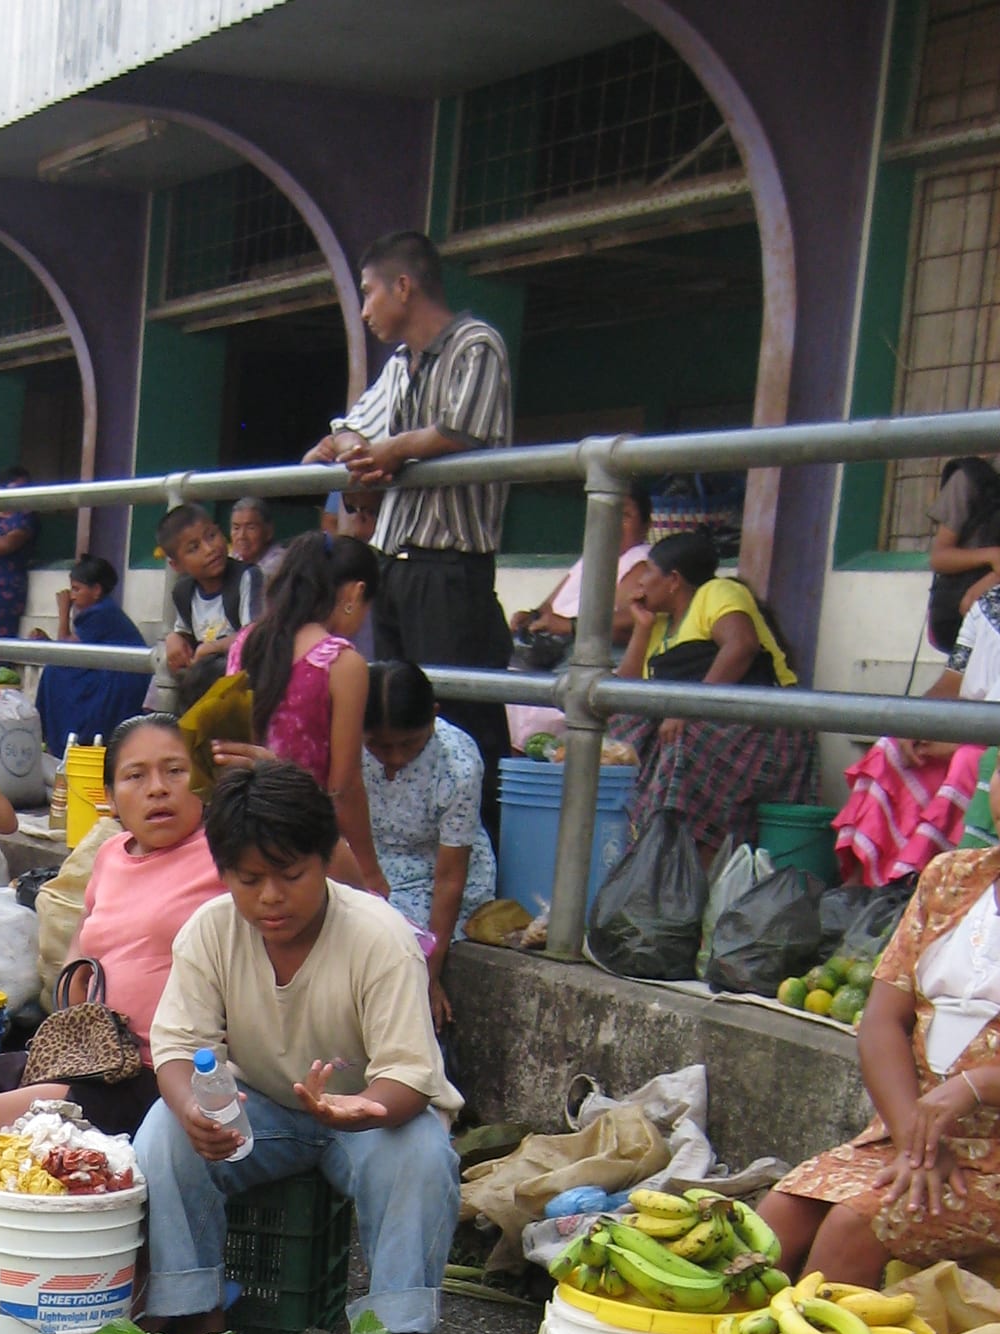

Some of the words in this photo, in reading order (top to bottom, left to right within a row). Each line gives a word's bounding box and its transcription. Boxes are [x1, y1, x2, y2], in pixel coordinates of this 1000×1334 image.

[40, 1292, 109, 1305] SHEETROCK
[40, 1311, 87, 1323] Lightweight
[89, 1310, 99, 1320] All
